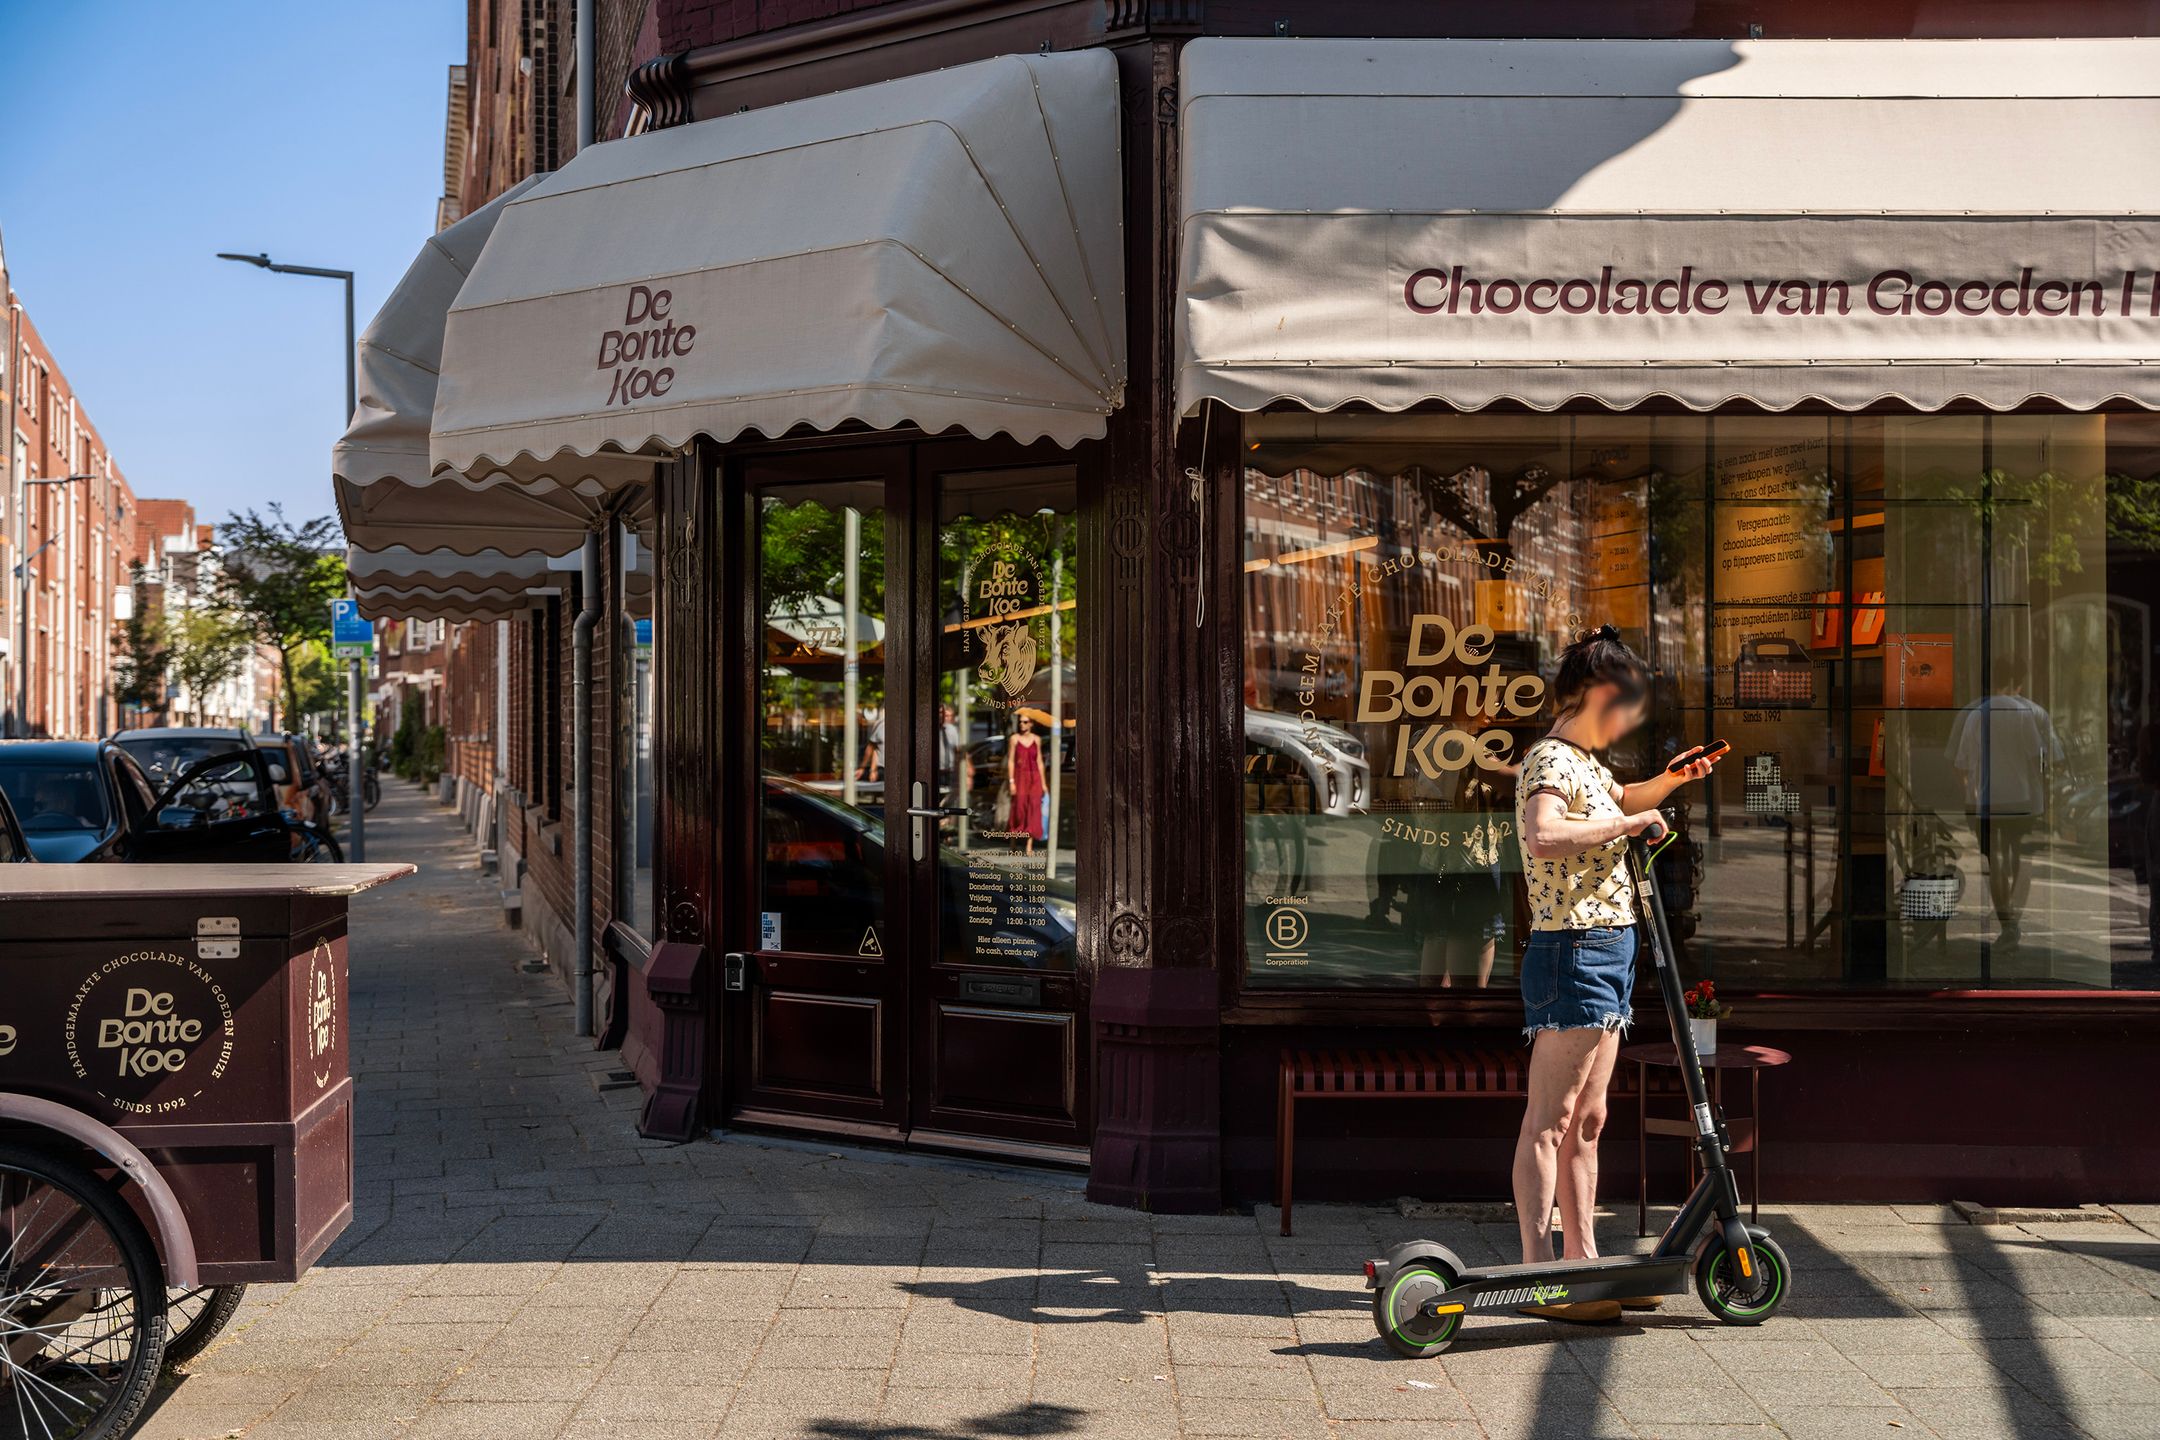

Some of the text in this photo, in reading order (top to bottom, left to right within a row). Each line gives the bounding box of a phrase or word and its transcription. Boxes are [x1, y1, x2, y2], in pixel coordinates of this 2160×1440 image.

[1404, 265, 1729, 315] Chocolade
[1743, 279, 1853, 315] van
[1867, 267, 2108, 317] Goeden
[625, 285, 673, 326] De
[597, 319, 697, 370] Bonte
[606, 366, 675, 406] Koe
[1758, 448, 1773, 461] met
[1772, 464, 1784, 476] we
[1758, 483, 1766, 496] of
[1767, 484, 1780, 497] per
[1737, 513, 1791, 532] Versgemaakte
[976, 542, 1025, 564] CHOCOLADE
[1025, 551, 1039, 570] VAN
[1722, 559, 1732, 571] op
[992, 561, 1015, 580] De
[1367, 546, 1568, 608] CHOCOLADE VAN
[980, 577, 1029, 599] Bonte
[335, 602, 350, 621] P
[989, 598, 1020, 616] Koe
[1406, 614, 1496, 667] De
[982, 696, 1006, 710] SINDS
[1357, 664, 1546, 723] Bonte
[1742, 711, 1782, 722] Sinds 1992
[1393, 724, 1515, 780] Koe
[1381, 817, 1450, 847] SINDS
[969, 883, 1004, 892] Donderdag
[1029, 884, 1046, 892] 18:00
[969, 894, 992, 903] Vrijdag
[1009, 895, 1023, 903] 9:30
[1029, 895, 1046, 903] 18:00
[1265, 895, 1308, 905] Certified
[969, 905, 998, 914] Zaterdag
[1009, 906, 1023, 914] 9:00
[1029, 907, 1046, 915] 17:30
[969, 916, 993, 925] Zondag
[1006, 917, 1023, 925] 12:00
[1029, 918, 1046, 926] 17:00
[1277, 915, 1298, 941] B
[975, 946, 985, 954] No
[1265, 958, 1309, 967] Corporation
[317, 970, 327, 999] De
[125, 988, 174, 1017] De
[66, 951, 234, 1079] HANDGEMAAKTE CHOCOLADE VAN GOEDEN HUIZE
[98, 1013, 202, 1048] Bonte
[119, 1047, 186, 1078] Koe
[113, 1097, 187, 1113] SINDS 1992
